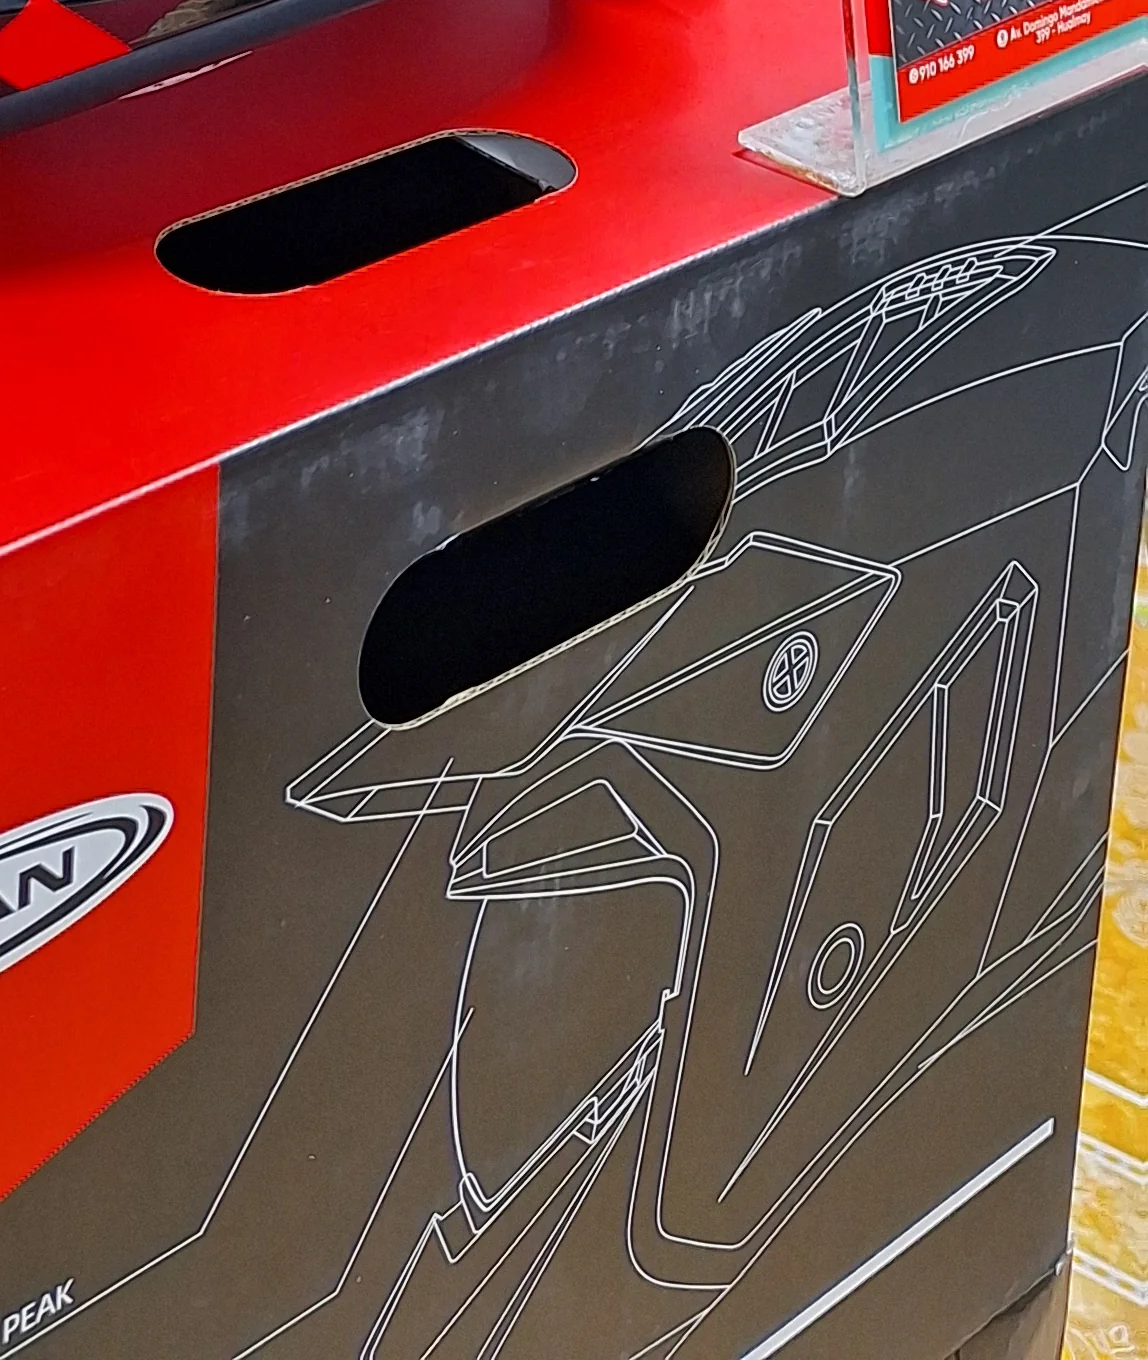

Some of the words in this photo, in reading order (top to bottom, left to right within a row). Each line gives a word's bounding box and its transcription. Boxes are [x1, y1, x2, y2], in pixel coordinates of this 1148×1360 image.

[1022, 13, 1058, 36] Domingo
[918, 61, 937, 82] 910
[938, 53, 956, 78] 166
[956, 44, 975, 70] 399
[2, 1278, 75, 1344] PEAK
